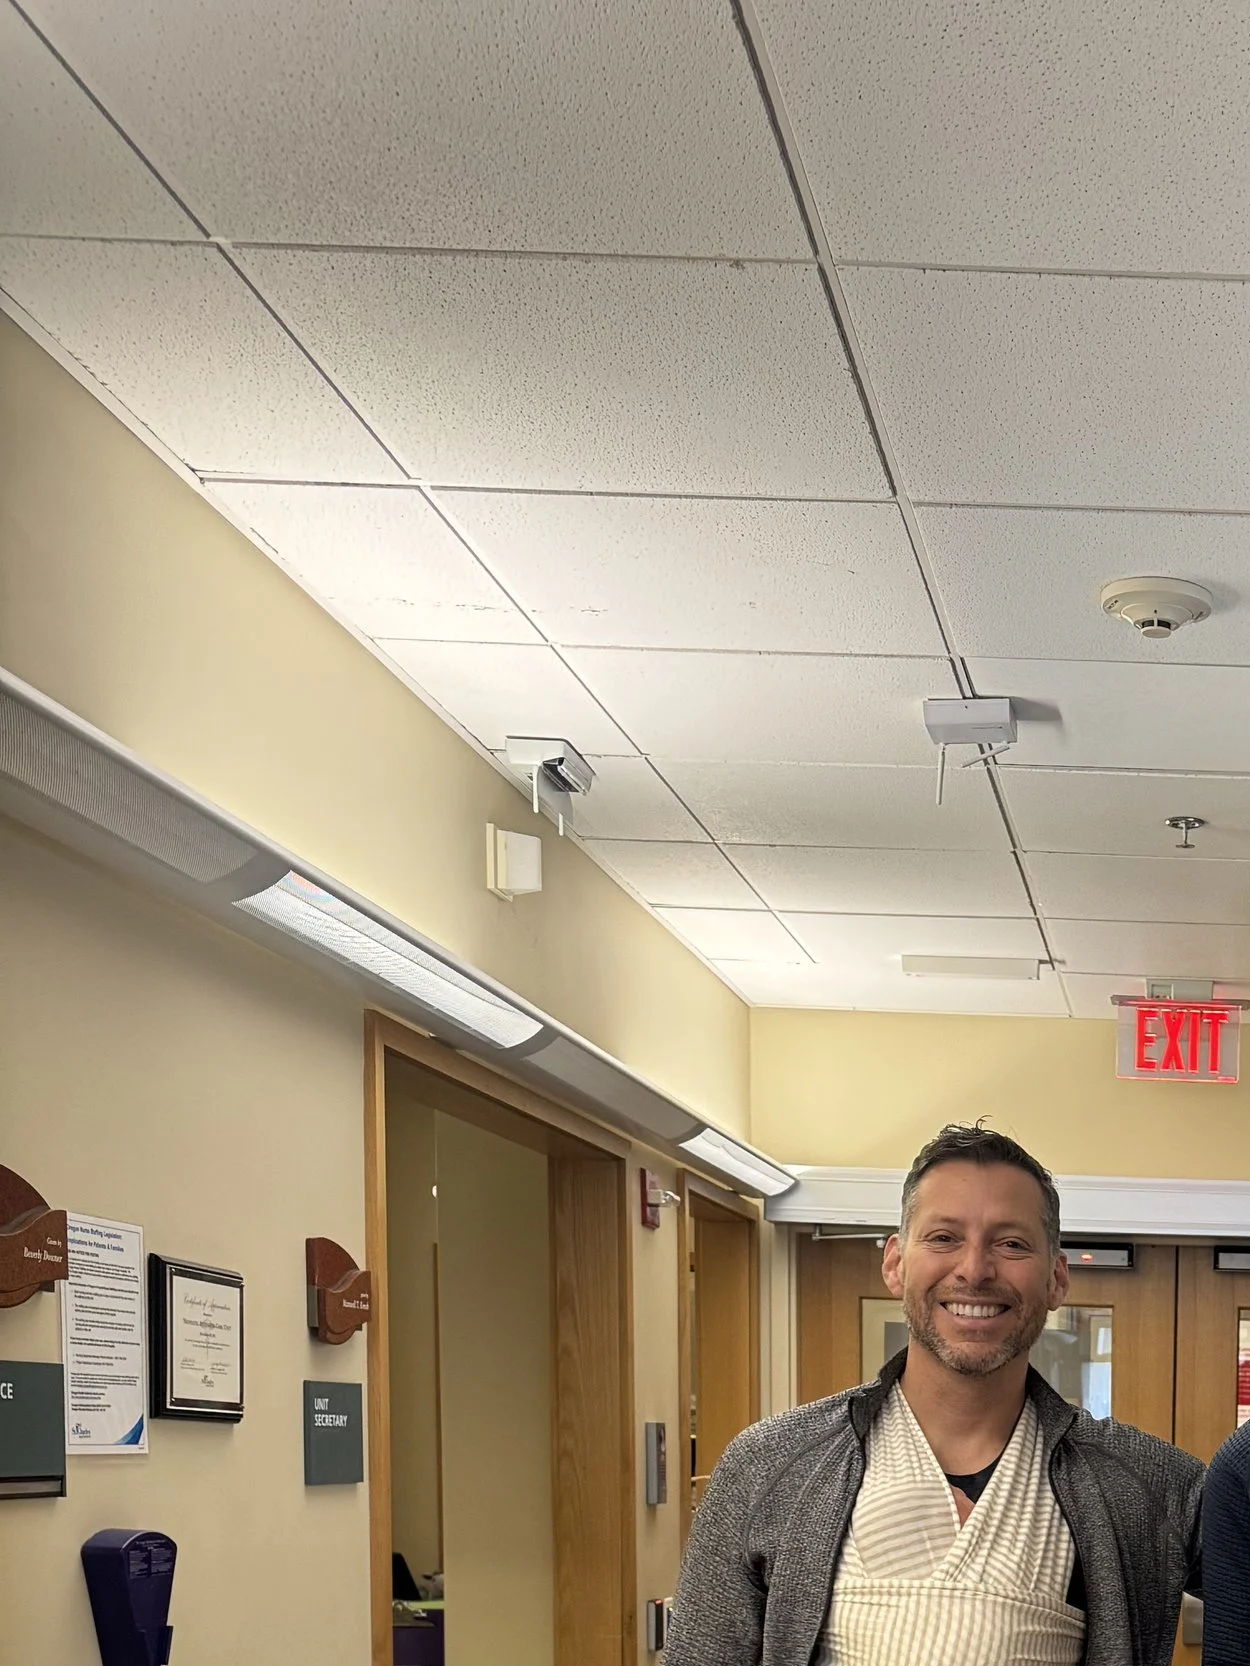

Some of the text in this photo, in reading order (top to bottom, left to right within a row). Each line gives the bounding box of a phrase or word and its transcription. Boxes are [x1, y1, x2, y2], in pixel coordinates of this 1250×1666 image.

[1135, 1007, 1229, 1074] EXIT
[23, 1246, 43, 1263] Beverly
[0, 1382, 14, 1400] CE
[314, 1397, 329, 1411] UNIT
[314, 1413, 348, 1428] SECRETARY
